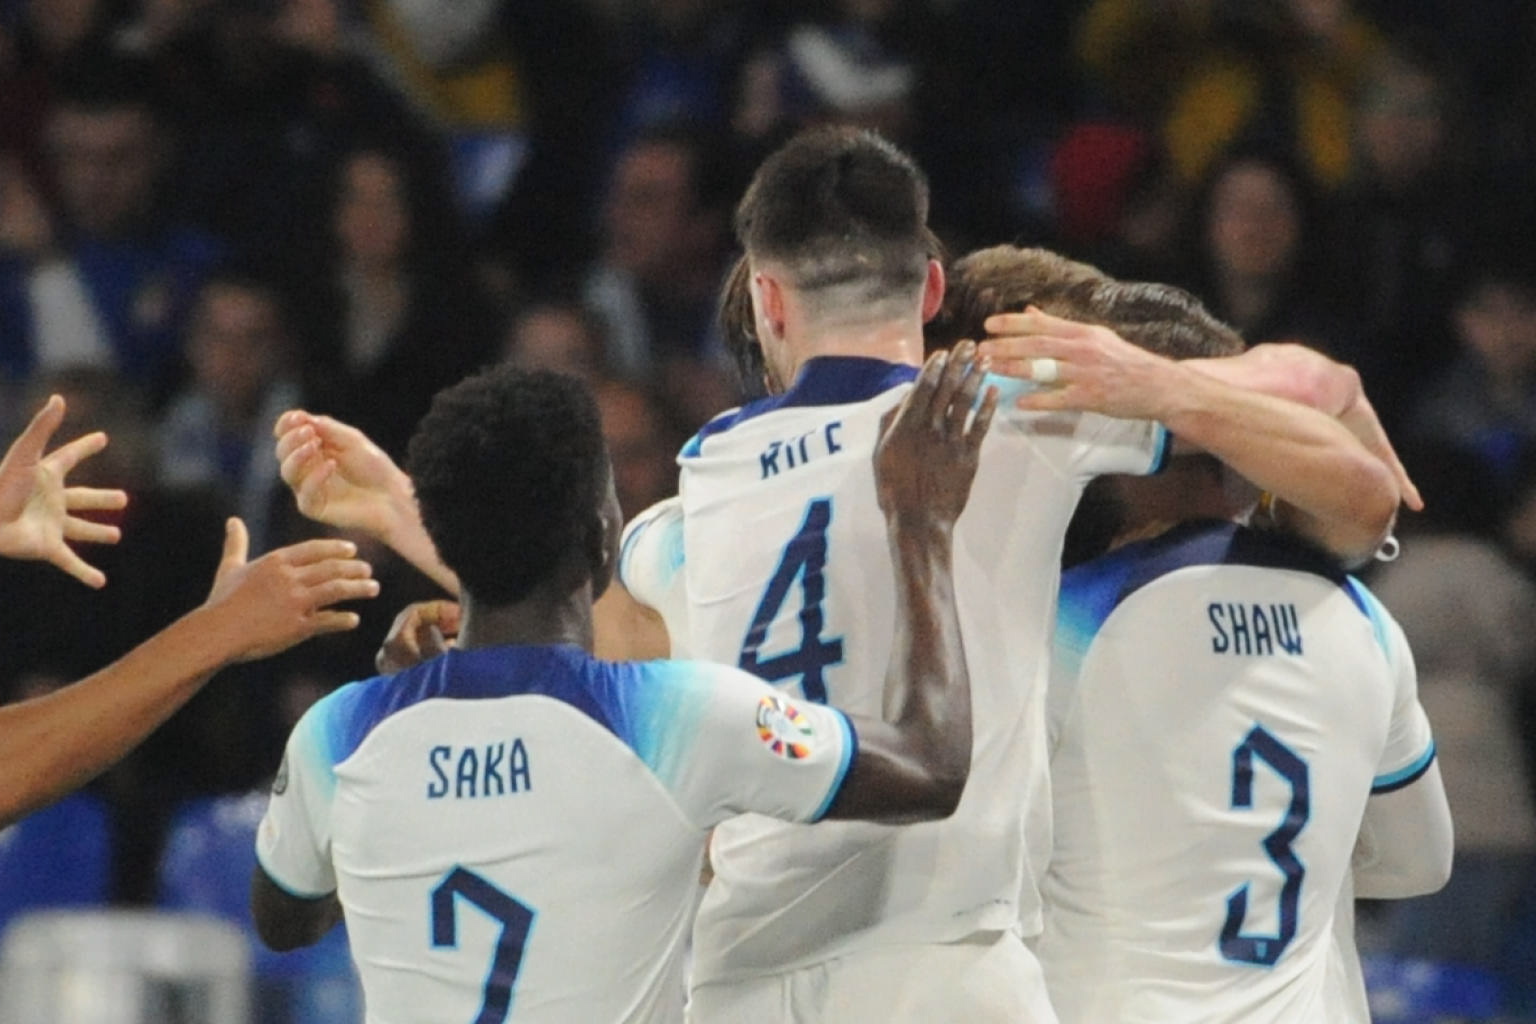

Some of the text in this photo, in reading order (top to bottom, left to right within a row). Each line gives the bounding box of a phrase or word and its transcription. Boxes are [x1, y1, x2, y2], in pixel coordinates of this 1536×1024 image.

[737, 496, 845, 704] 4
[1208, 603, 1303, 656] SHAW
[427, 737, 532, 799] SAKA
[1218, 721, 1312, 970] 3
